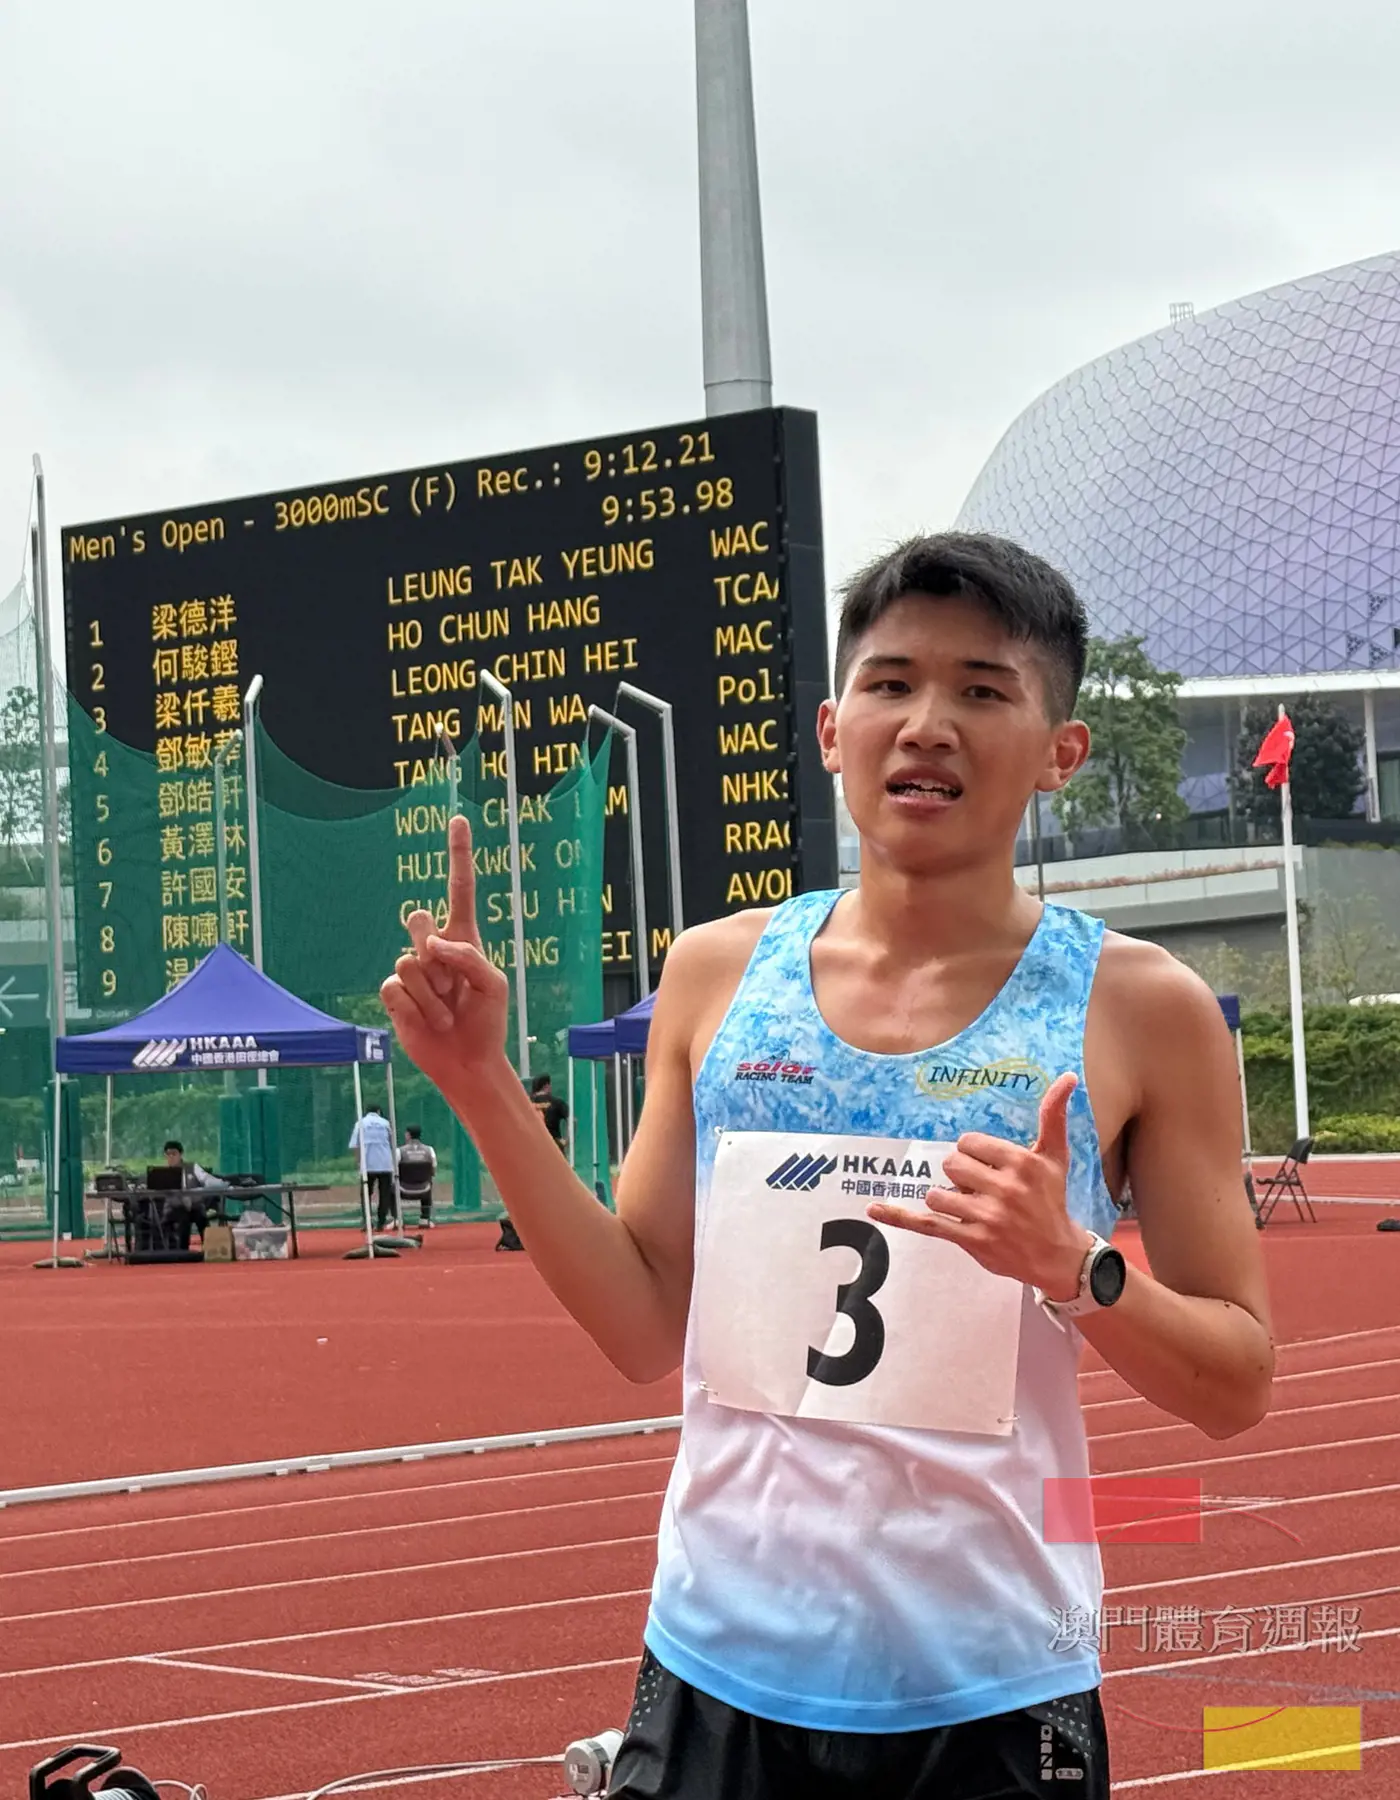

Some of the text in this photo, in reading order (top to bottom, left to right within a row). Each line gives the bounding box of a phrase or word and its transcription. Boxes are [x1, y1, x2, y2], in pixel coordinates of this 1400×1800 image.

[69, 525, 146, 563] Men's
[161, 516, 225, 553] Open
[274, 485, 390, 531] 3000mSC
[410, 472, 456, 516] (F)
[477, 461, 561, 498] Rec.:
[584, 431, 715, 481] 9:12.21
[602, 477, 734, 527] 9:53.98
[89, 521, 770, 647] 1 梁德洋 LEUNG TAK YEUNG WAC
[91, 664, 105, 691] 2
[388, 619, 422, 652] HO
[440, 606, 509, 644] CHUN
[527, 595, 600, 633] HANG
[713, 571, 780, 607] TCA
[93, 706, 107, 734] 3
[392, 659, 475, 697] LEONG
[495, 647, 565, 684] CHIN
[584, 638, 638, 673] HEI
[94, 751, 109, 777] 4
[392, 708, 460, 743] TANG
[548, 694, 587, 726] WA
[718, 668, 785, 706] Pol
[96, 795, 110, 822] 5
[393, 755, 462, 789] TANG
[718, 719, 778, 755] WAC
[98, 838, 112, 866] 6
[395, 802, 463, 836] WON
[99, 882, 113, 908] 7
[162, 862, 246, 906] 許國安
[398, 852, 447, 882] HUI
[101, 925, 115, 952] 8
[103, 969, 117, 996] 9
[190, 1035, 257, 1051] HKAAA
[735, 1072, 814, 1084] RACING TEAM
[928, 1066, 1039, 1091] INFINITY
[841, 1179, 960, 1200] 中國香港田徑
[843, 1155, 931, 1178] HKAAA
[806, 1218, 890, 1387] 3
